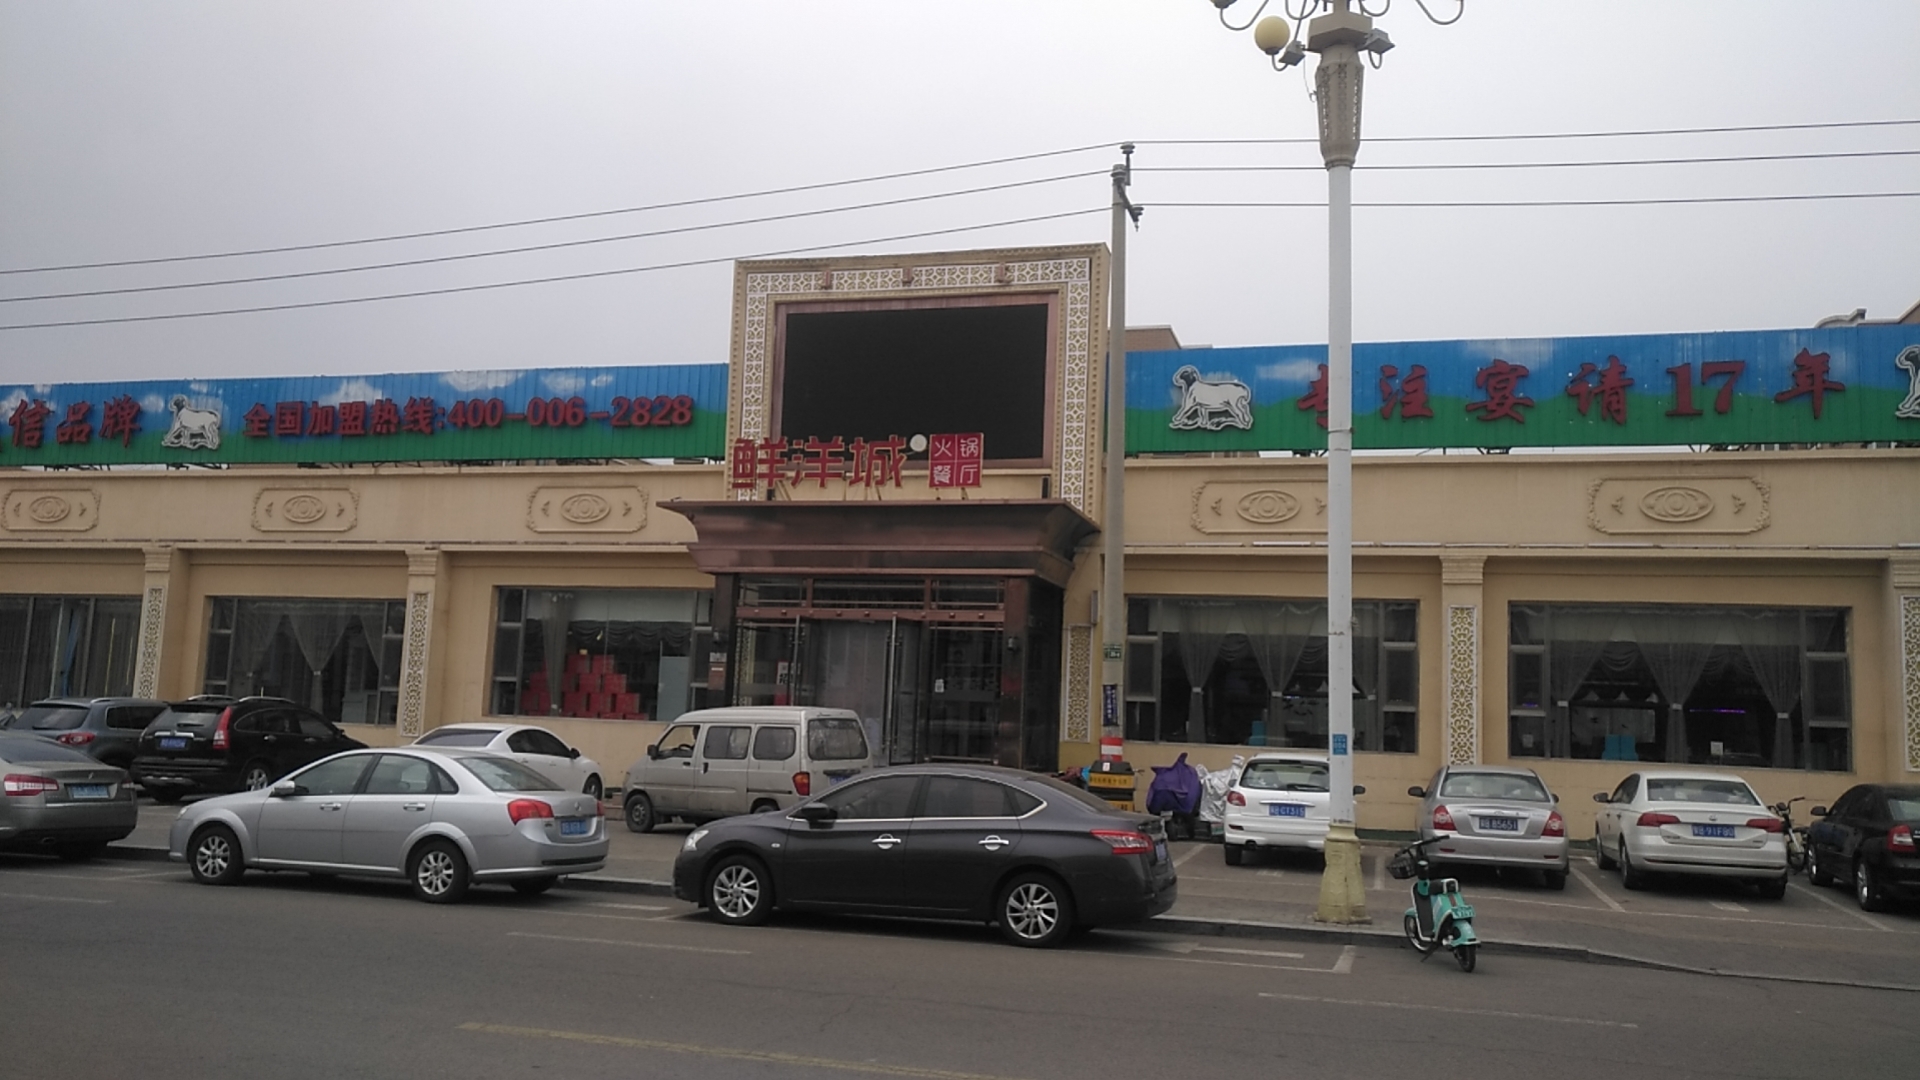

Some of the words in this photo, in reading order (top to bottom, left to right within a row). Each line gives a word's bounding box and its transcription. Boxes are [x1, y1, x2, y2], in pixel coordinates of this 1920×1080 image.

[9, 394, 144, 448] 信品牌
[934, 437, 979, 458] 火锅
[933, 463, 979, 485] 餐厅
